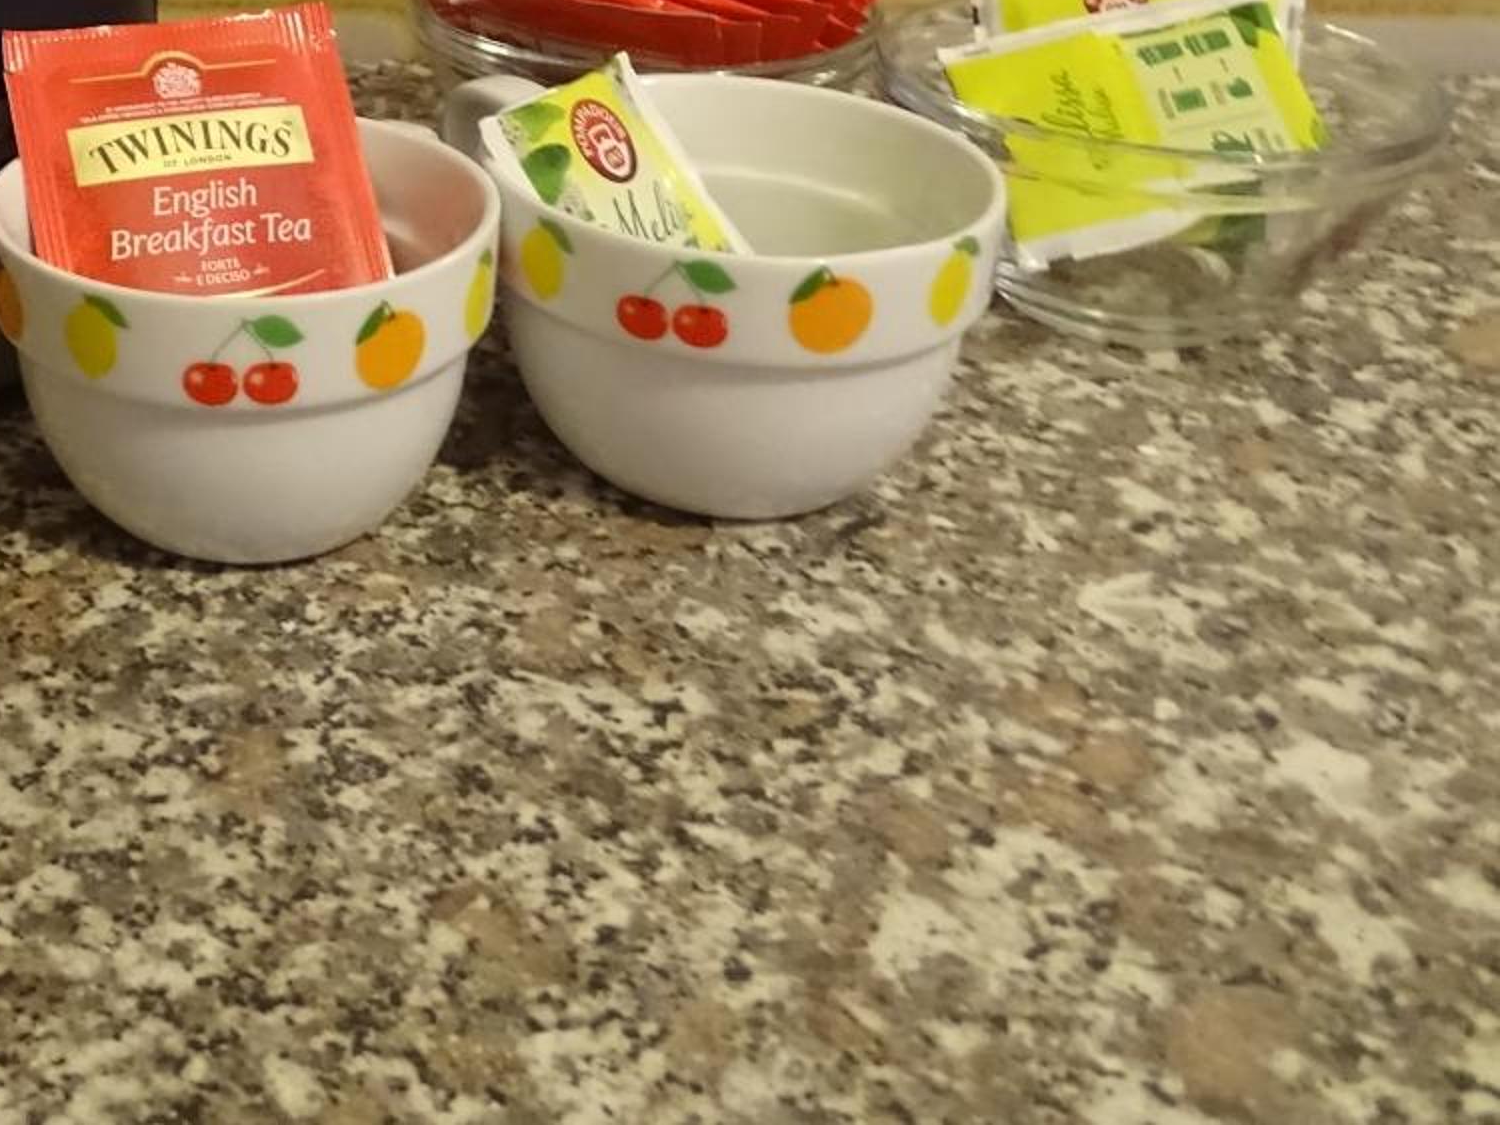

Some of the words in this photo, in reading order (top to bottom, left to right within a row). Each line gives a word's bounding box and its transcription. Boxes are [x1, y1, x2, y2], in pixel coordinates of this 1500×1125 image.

[88, 119, 292, 175] TWININGS
[183, 154, 233, 168] LONDON
[153, 177, 258, 218] English
[110, 217, 257, 261] Breakfast
[259, 212, 312, 243] Tea
